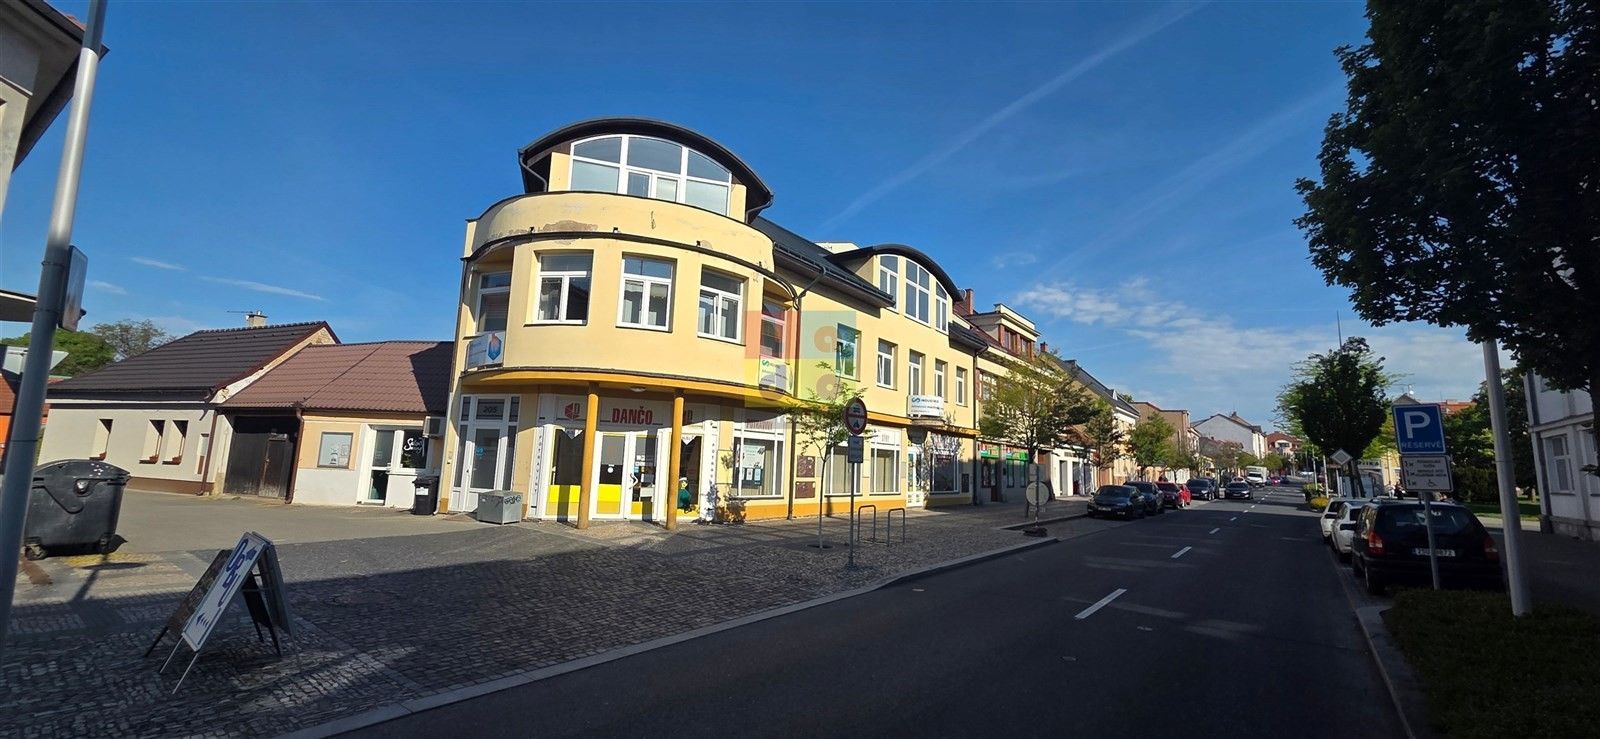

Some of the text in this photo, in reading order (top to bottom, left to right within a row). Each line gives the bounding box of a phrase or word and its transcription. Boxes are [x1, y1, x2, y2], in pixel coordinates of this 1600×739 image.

[482, 405, 498, 414] 205
[611, 405, 653, 426] DANČO
[1403, 410, 1431, 439] P
